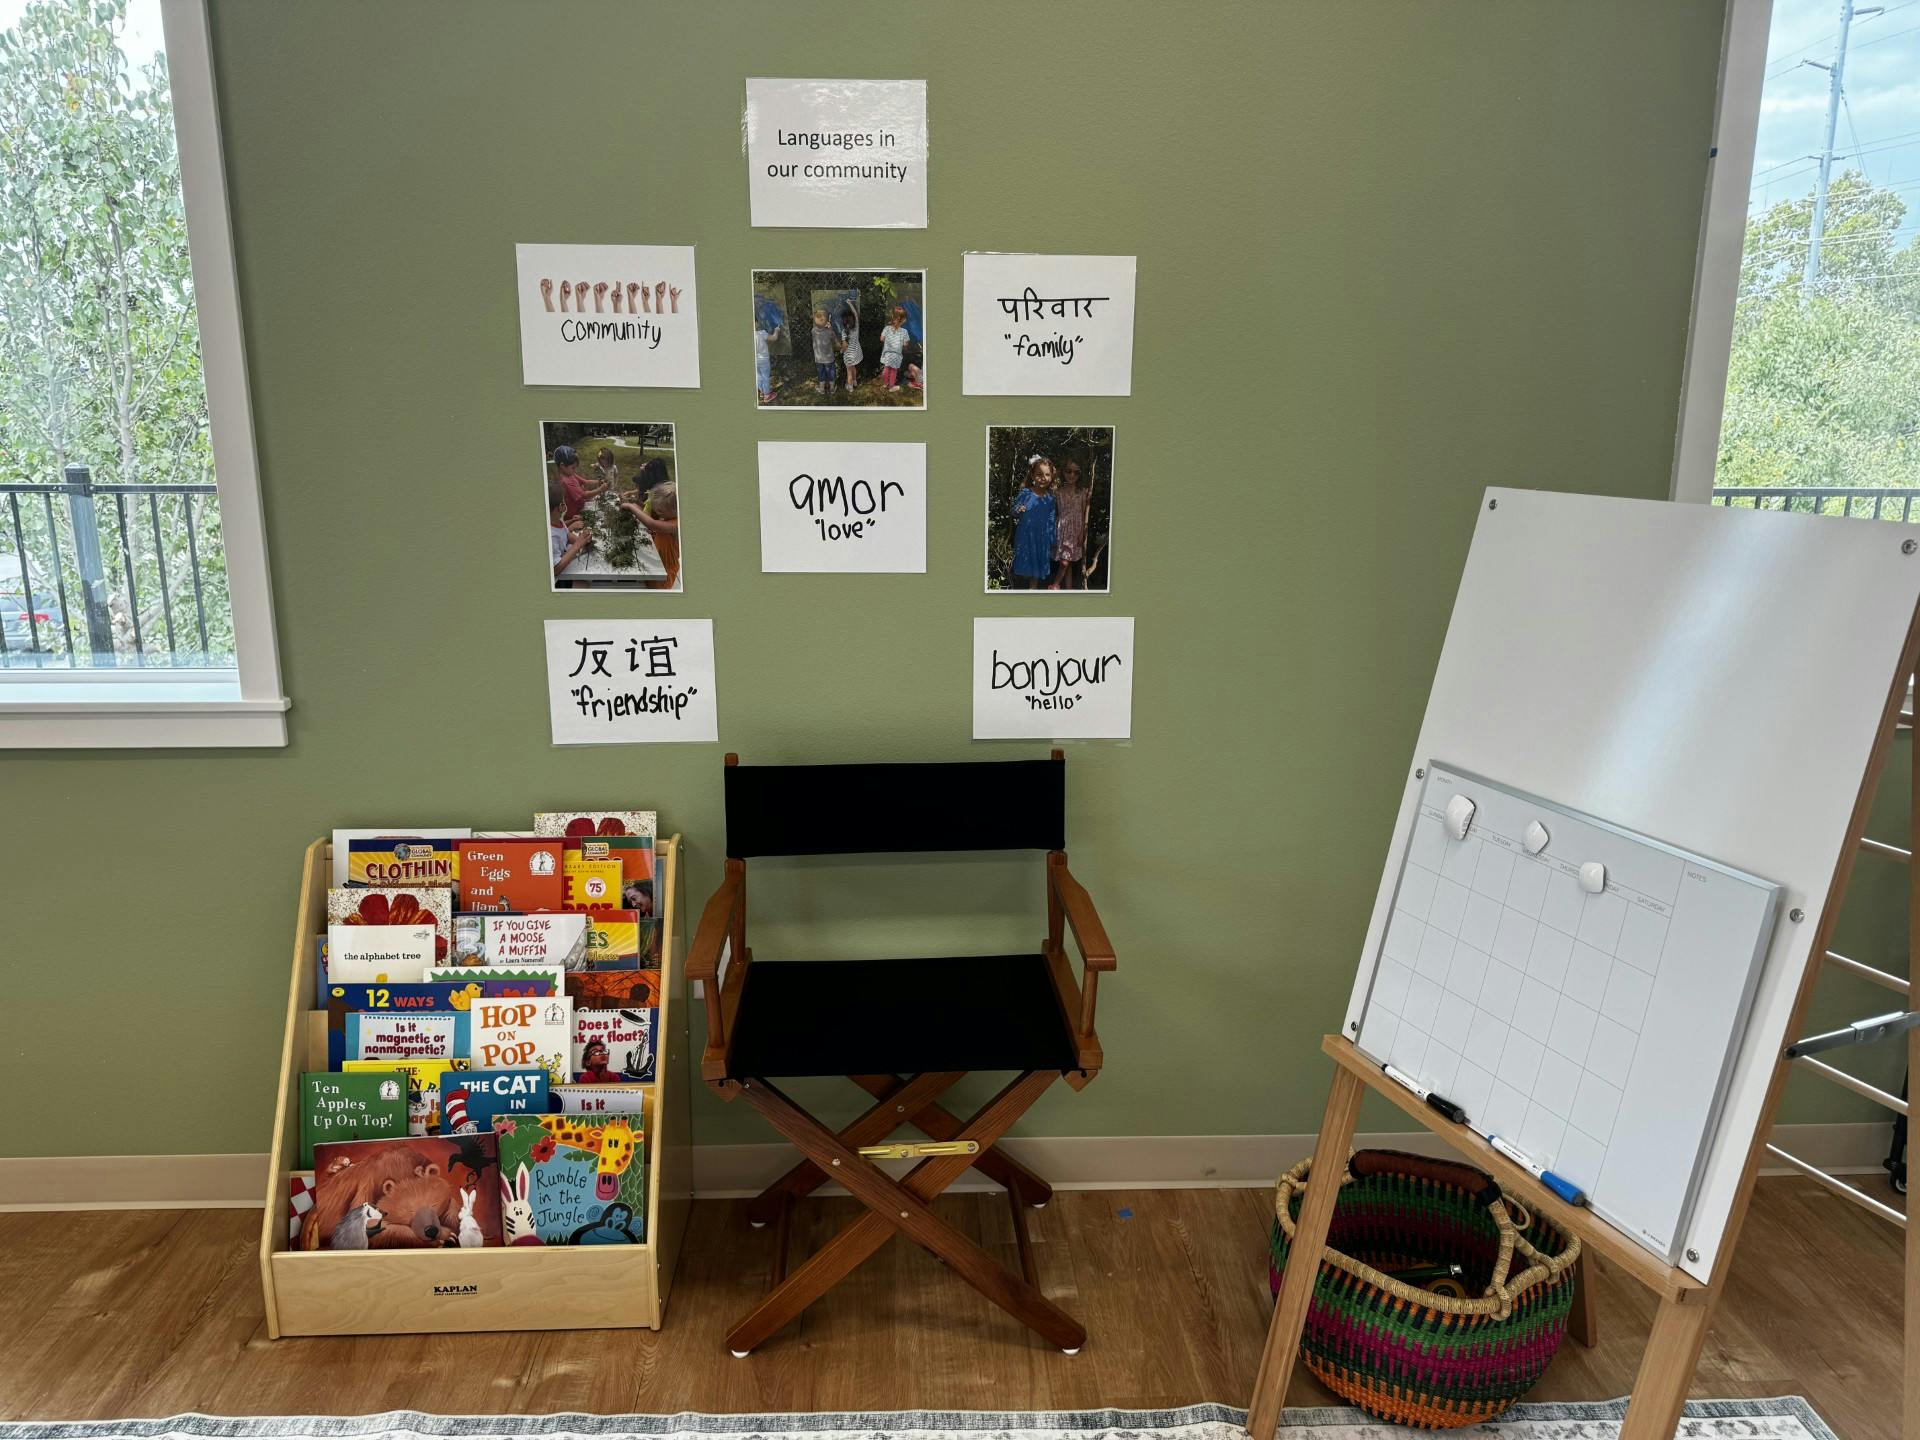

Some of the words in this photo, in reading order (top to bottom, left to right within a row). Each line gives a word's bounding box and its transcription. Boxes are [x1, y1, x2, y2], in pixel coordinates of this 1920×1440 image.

[778, 129, 873, 150] Languages
[880, 130, 895, 147] in
[767, 164, 799, 178] our
[804, 162, 907, 183] community
[997, 286, 1110, 323] परिवार
[561, 317, 662, 350] Community
[814, 518, 876, 541] "love"
[568, 635, 678, 678] 友谊
[991, 649, 1122, 696] bonjour
[467, 851, 504, 862] Green
[365, 859, 452, 880] CLOTHIN
[480, 866, 512, 882] Eggs
[1687, 871, 1707, 883] NOTES
[470, 886, 494, 896] and
[589, 882, 602, 893] 75
[471, 901, 499, 912] Ham
[492, 920, 504, 931] IF
[506, 920, 525, 931] YOU
[526, 919, 551, 931] GIVE
[500, 933, 506, 944] A
[510, 932, 545, 944] MOOSE
[587, 931, 609, 948] ES
[344, 952, 358, 961] the
[360, 952, 400, 962] alphabet
[402, 952, 421, 960] tree
[498, 945, 505, 956] A
[509, 944, 547, 955] MUFFIN
[366, 988, 390, 1008] 12
[393, 996, 435, 1008] WAYS
[480, 1003, 537, 1029] HOP
[395, 1023, 405, 1033] Is
[408, 1022, 417, 1033] it
[578, 1019, 609, 1031] Does
[612, 1017, 623, 1029] it
[376, 1033, 431, 1046] magnetic
[433, 1034, 446, 1043] or
[497, 1030, 517, 1041] ON
[589, 1033, 604, 1043] or
[607, 1029, 645, 1043] float?
[364, 1044, 446, 1057] nonmagnetic?
[480, 1041, 536, 1067] POP
[312, 1080, 340, 1094] Ten
[460, 1081, 490, 1093] THE
[493, 1075, 541, 1096] CAT
[316, 1096, 367, 1112] Apples
[510, 1099, 526, 1109] IN
[580, 1099, 592, 1111] Is
[595, 1098, 605, 1110] it
[313, 1115, 332, 1129] Up
[336, 1114, 357, 1127] On
[361, 1113, 393, 1129] Top!
[535, 1166, 587, 1190] Rumble
[539, 1192, 552, 1205] in
[559, 1189, 581, 1205] the
[536, 1206, 585, 1228] Jungle
[433, 1284, 478, 1293] KAPLAN
